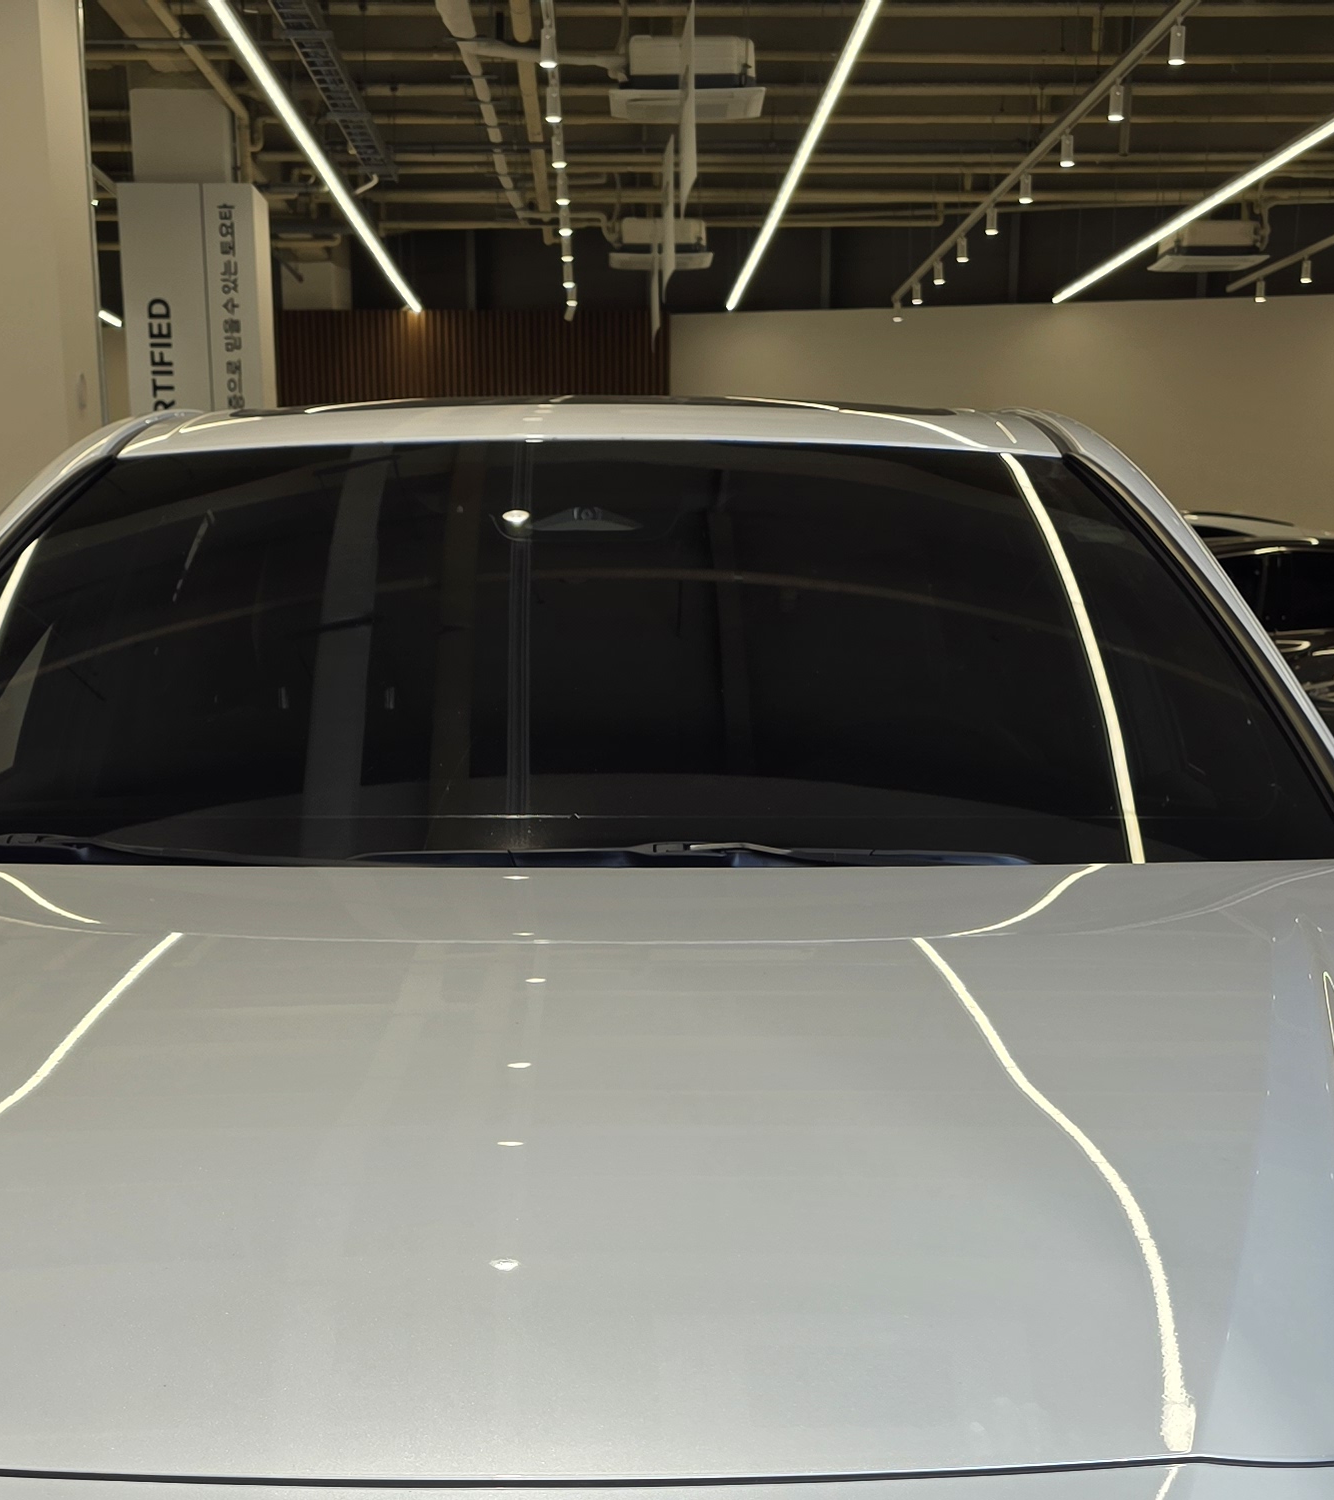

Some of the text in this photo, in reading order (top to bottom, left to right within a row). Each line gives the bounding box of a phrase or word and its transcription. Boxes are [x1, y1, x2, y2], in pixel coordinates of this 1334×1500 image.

[217, 203, 236, 258] 토요타
[220, 259, 239, 294] 있는
[222, 297, 240, 316] 수
[148, 297, 176, 412] RTIFIED
[226, 358, 246, 410] 증으로
